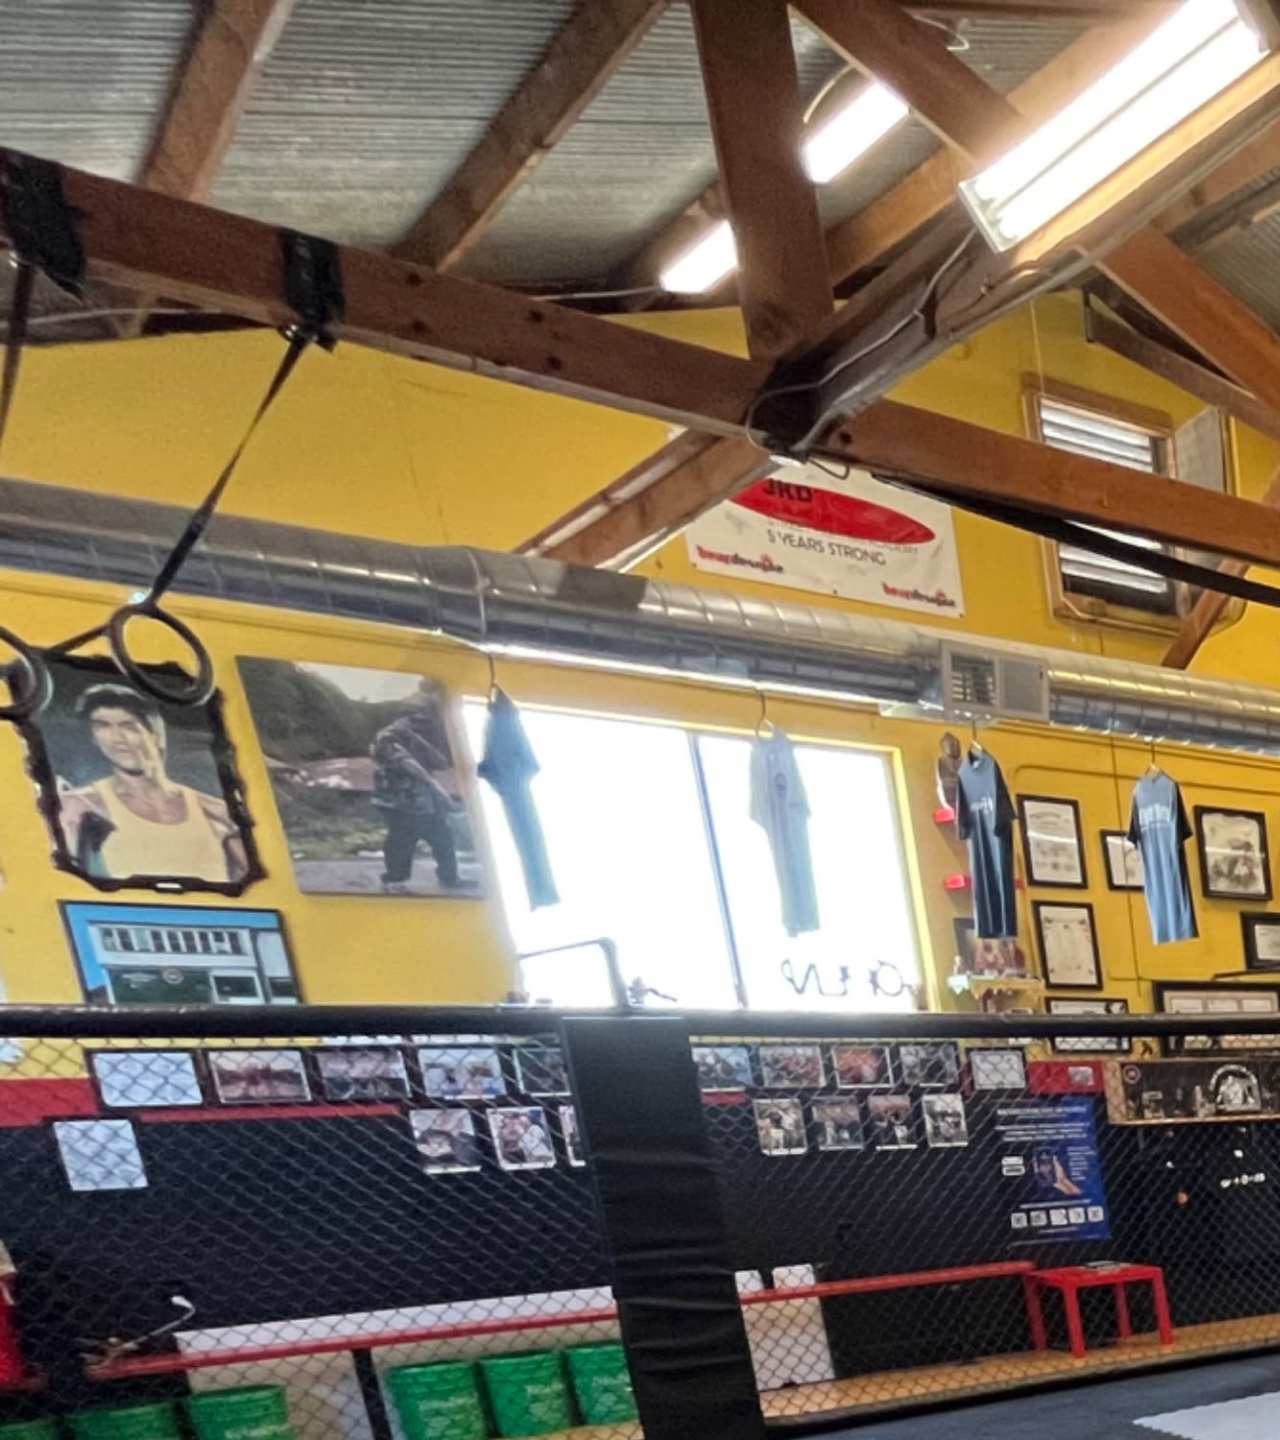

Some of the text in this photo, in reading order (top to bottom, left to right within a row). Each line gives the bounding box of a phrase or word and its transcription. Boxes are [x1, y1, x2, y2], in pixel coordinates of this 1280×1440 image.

[763, 478, 813, 503] JKD
[778, 532, 826, 553] YEARS
[827, 543, 887, 566] STRONG
